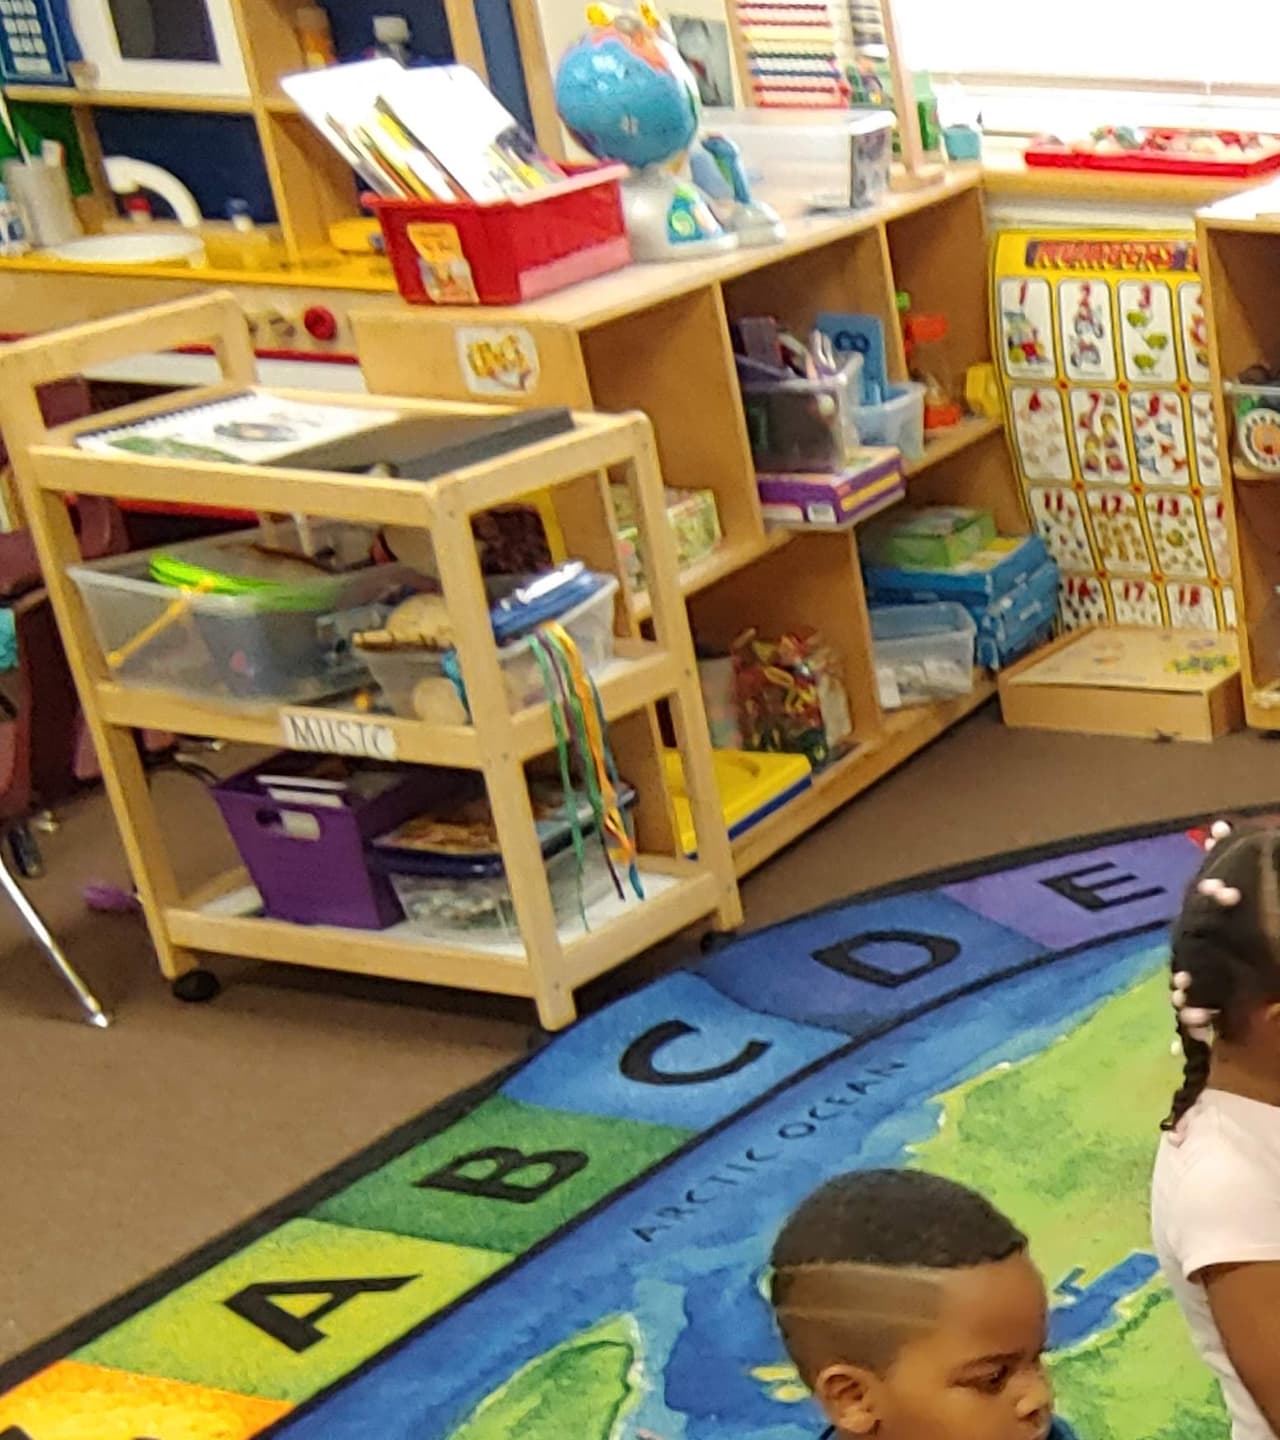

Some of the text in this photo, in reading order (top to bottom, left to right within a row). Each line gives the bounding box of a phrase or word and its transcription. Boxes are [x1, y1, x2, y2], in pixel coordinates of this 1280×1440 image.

[287, 714, 387, 757] MUSIC
[1038, 861, 1163, 914] E
[810, 929, 962, 989] D
[619, 1018, 773, 1087] C
[412, 1146, 590, 1204] B
[630, 1061, 907, 1243] ARCTIC OCEAN
[223, 1273, 423, 1353] A
